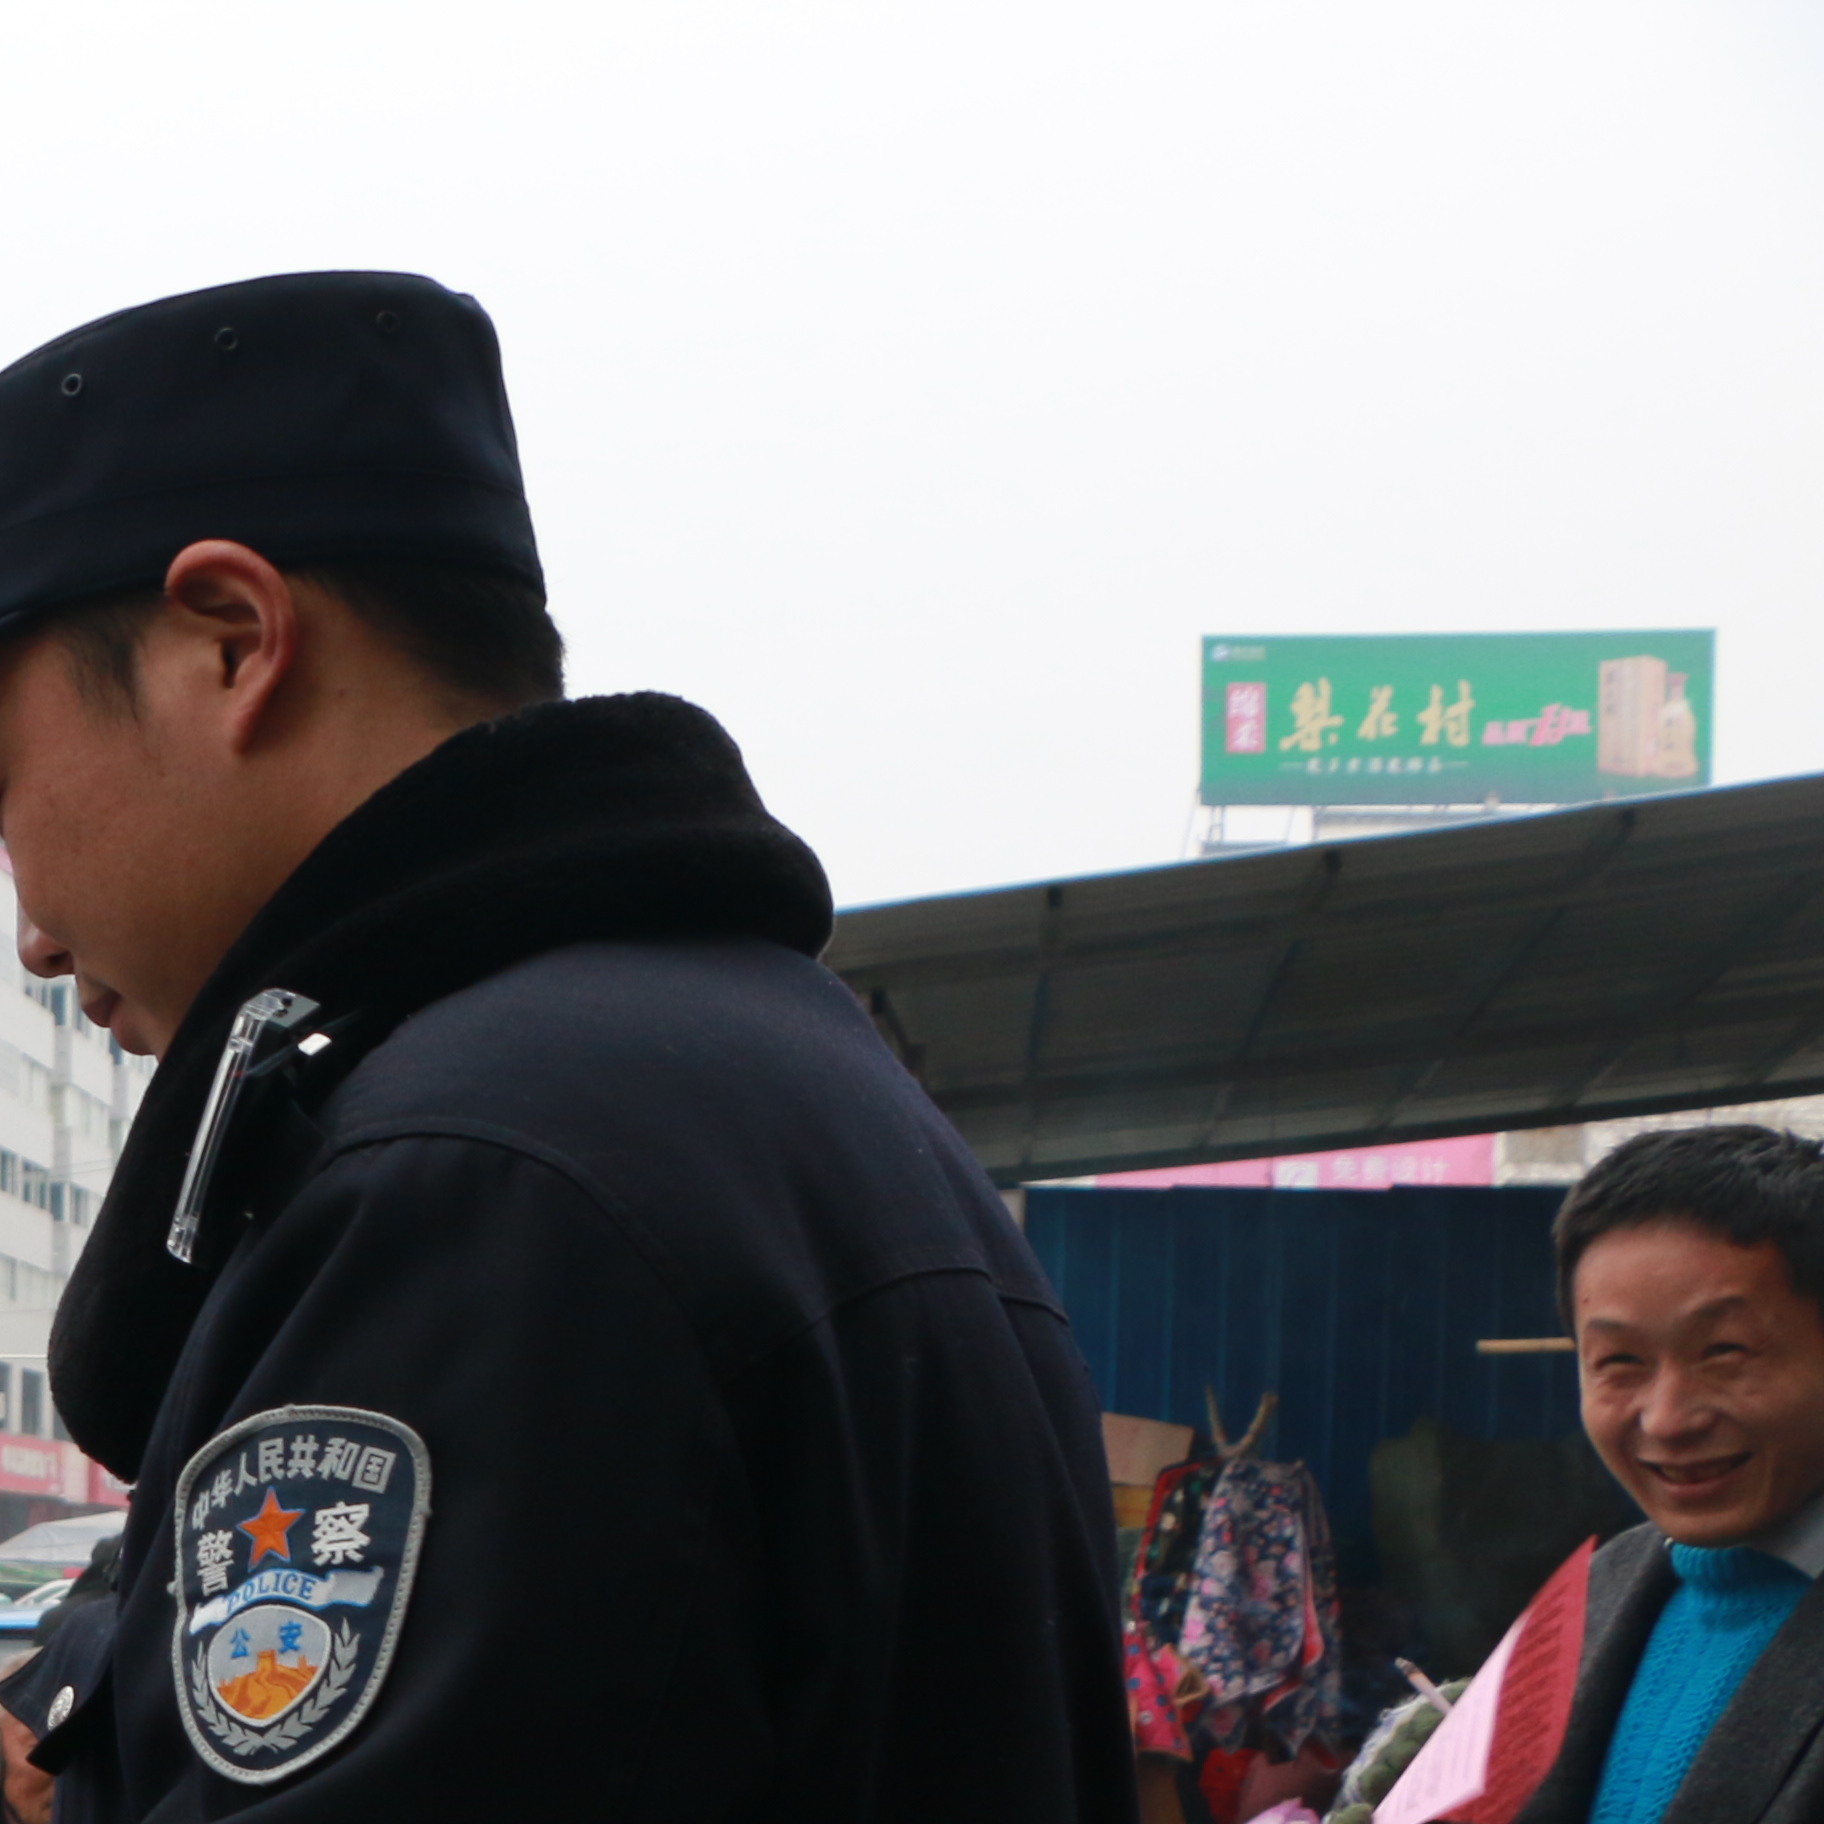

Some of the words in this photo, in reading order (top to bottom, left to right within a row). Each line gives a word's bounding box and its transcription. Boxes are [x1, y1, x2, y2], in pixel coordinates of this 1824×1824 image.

[191, 1435, 396, 1530] 中华人民共和国
[226, 1571, 317, 1610] POLICE
